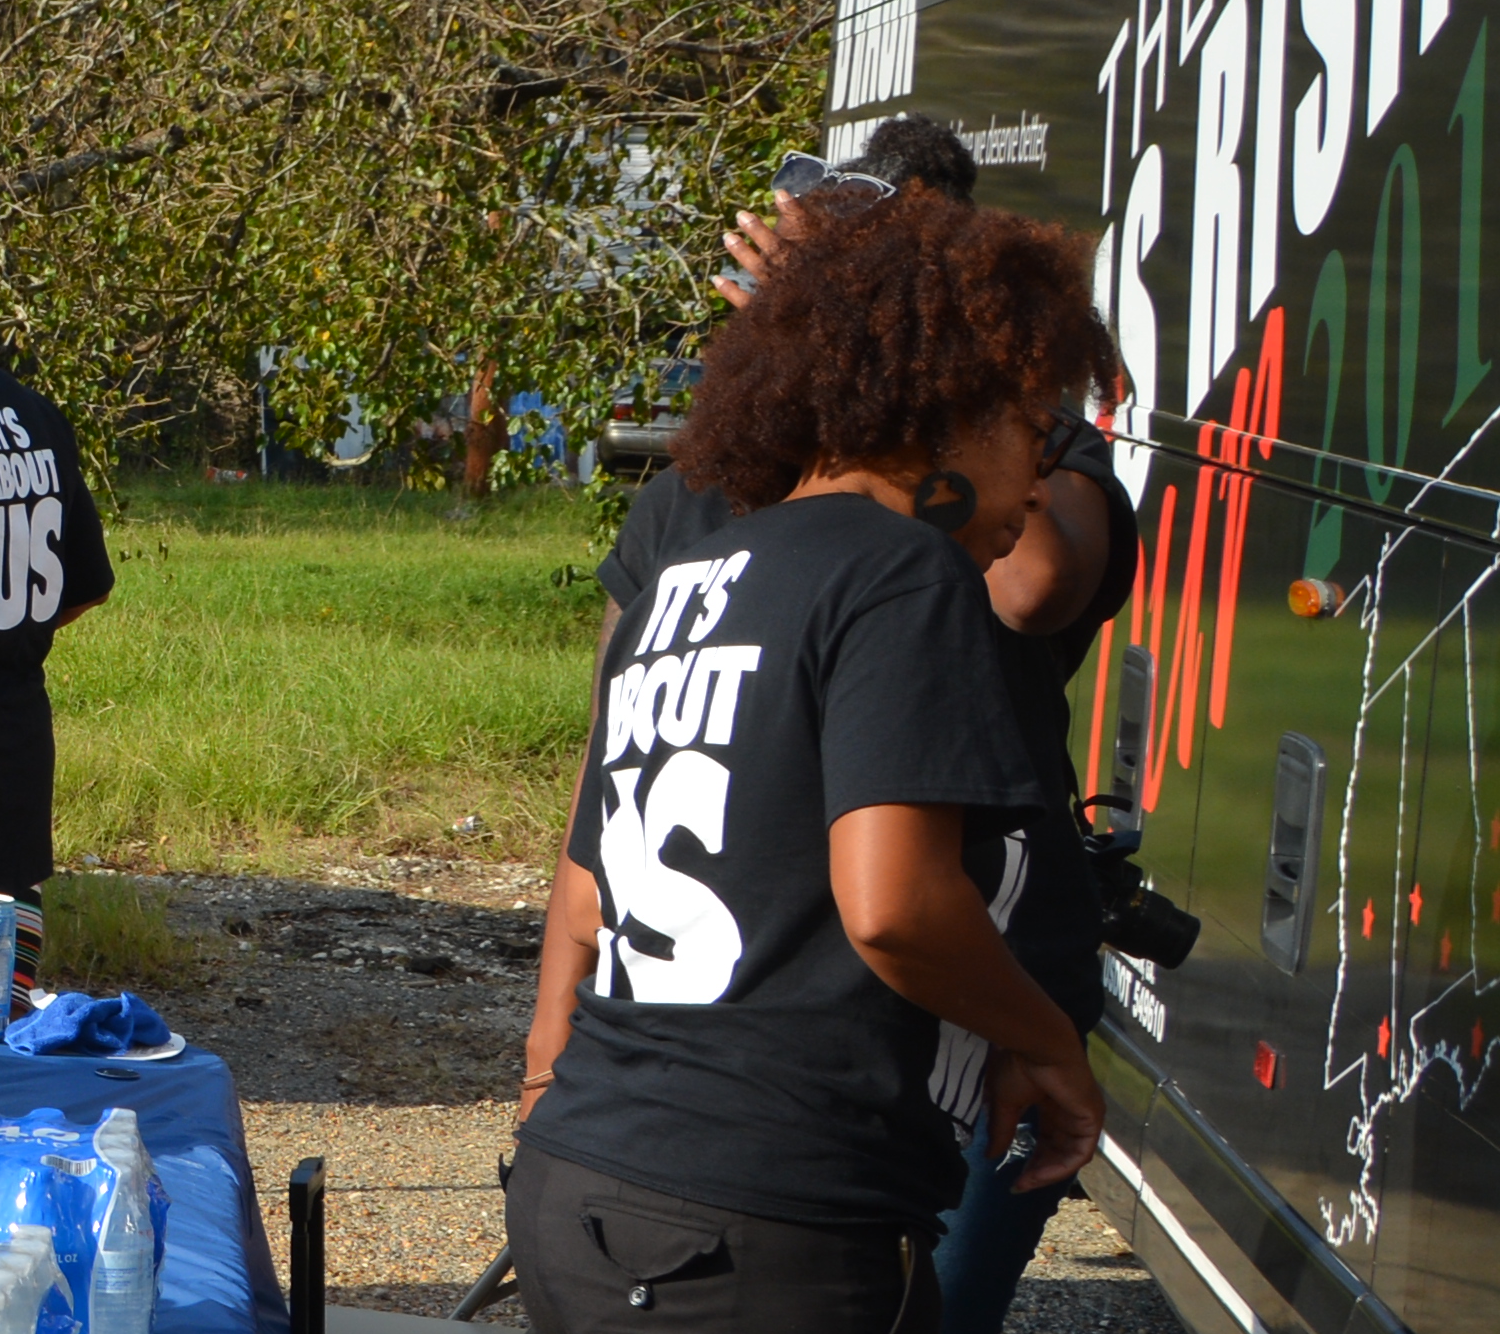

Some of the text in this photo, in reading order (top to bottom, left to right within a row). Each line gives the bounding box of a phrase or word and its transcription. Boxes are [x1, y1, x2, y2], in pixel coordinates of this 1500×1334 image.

[986, 114, 1018, 164] deserve
[635, 550, 751, 655] IT'S
[603, 646, 761, 765] BOUT
[1103, 950, 1133, 1008] USDOT
[1132, 980, 1165, 1042] 549610
